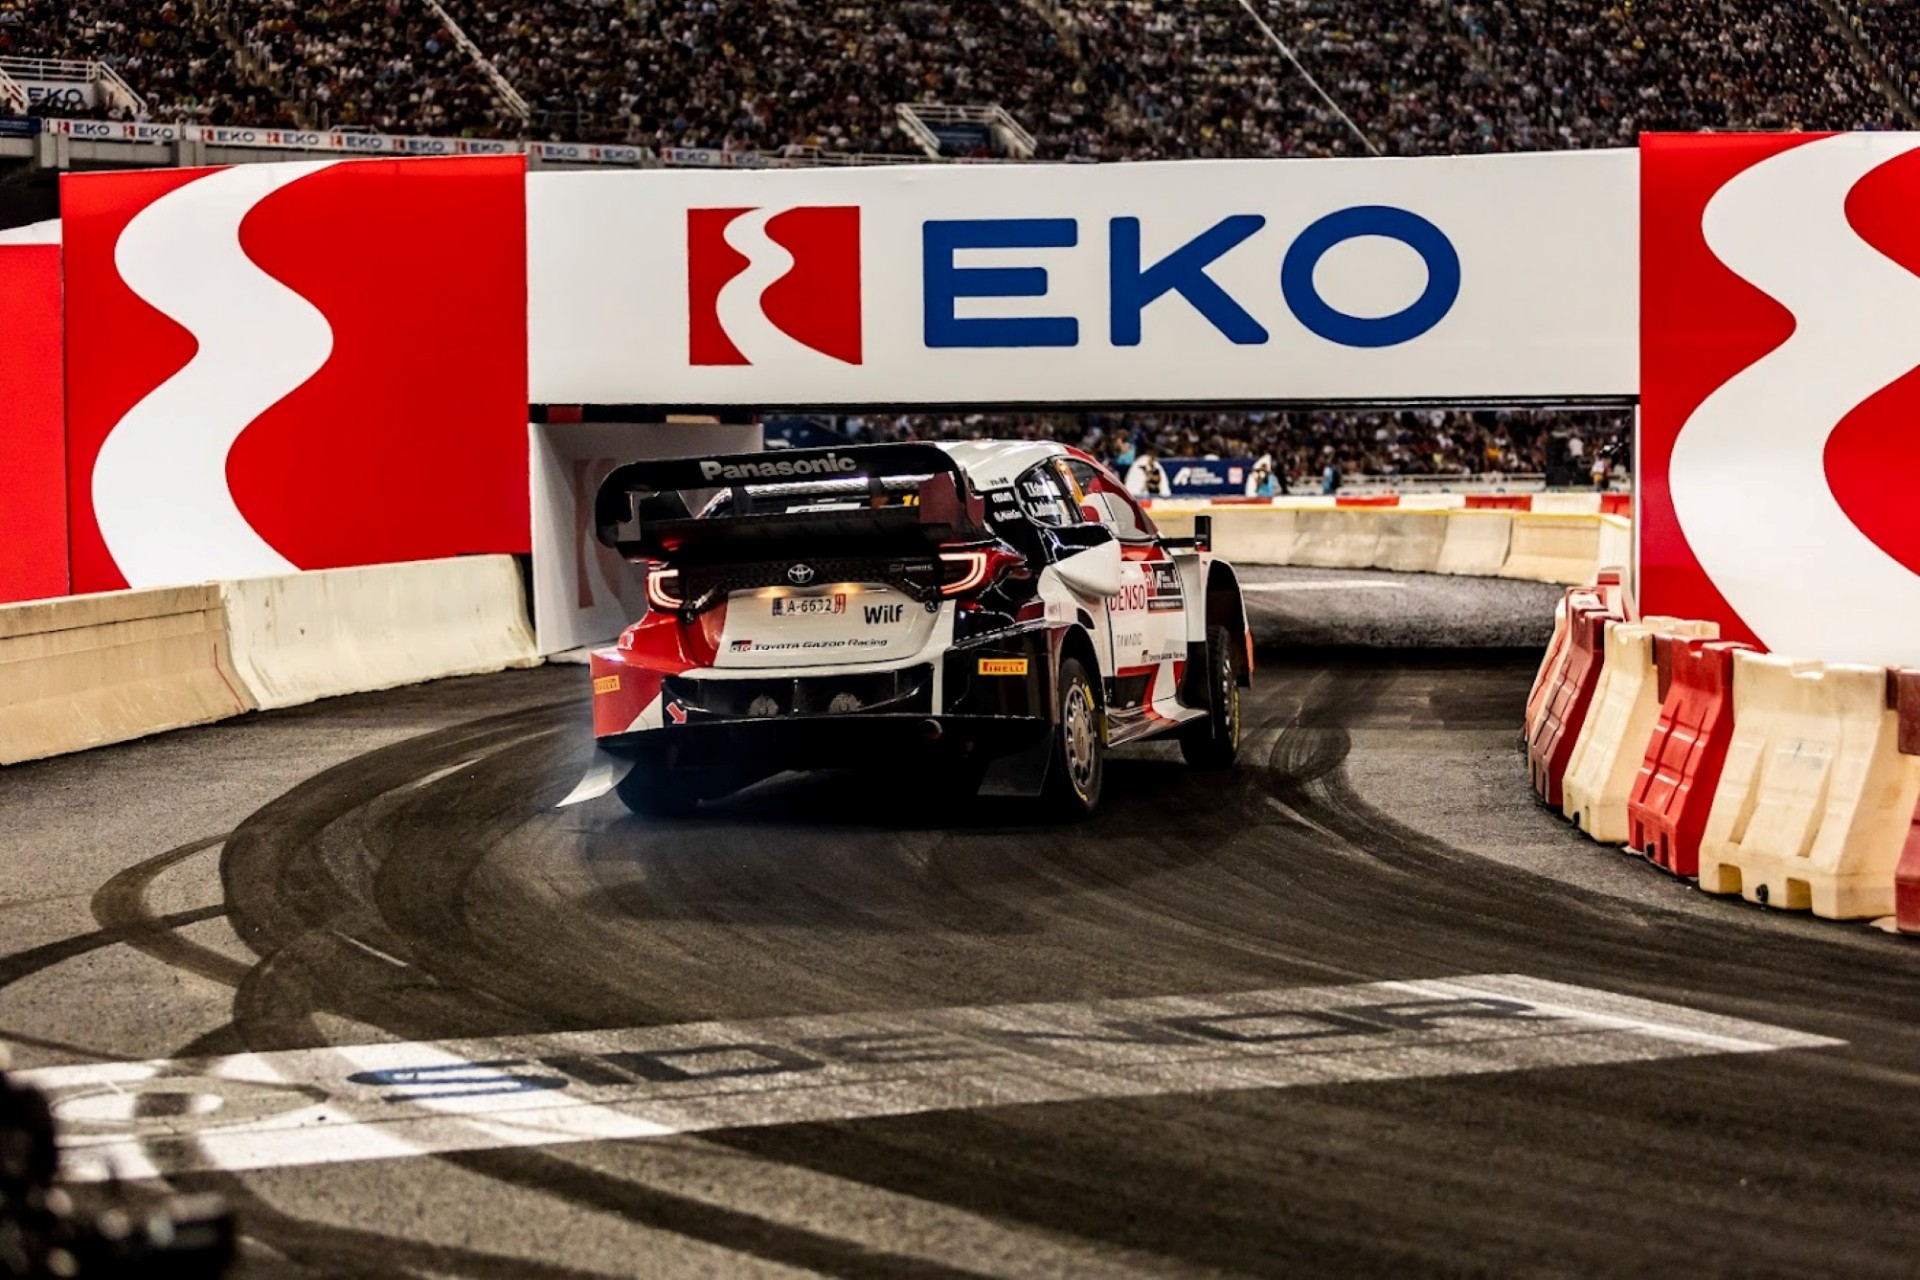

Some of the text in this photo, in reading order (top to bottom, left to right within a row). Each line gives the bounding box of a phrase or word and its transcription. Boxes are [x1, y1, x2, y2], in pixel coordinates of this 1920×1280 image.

[28, 87, 83, 104] EKO
[74, 123, 110, 135] EKO
[138, 127, 173, 139] EKO
[217, 130, 255, 143] EKO
[282, 133, 319, 145] EKO
[346, 136, 382, 149] EKO
[409, 140, 444, 152] EKO
[470, 143, 504, 154] EKO
[545, 145, 578, 157] EKO
[604, 149, 637, 160] EKO
[675, 152, 709, 163] EKO
[922, 205, 1461, 348] EKO
[700, 453, 858, 481] Panasonic
[1110, 584, 1146, 611] DENSO
[864, 604, 904, 624] Wilf
[754, 643, 800, 651] TOYOTA
[848, 638, 888, 647] Racing
[982, 661, 1025, 673] PIRELLI
